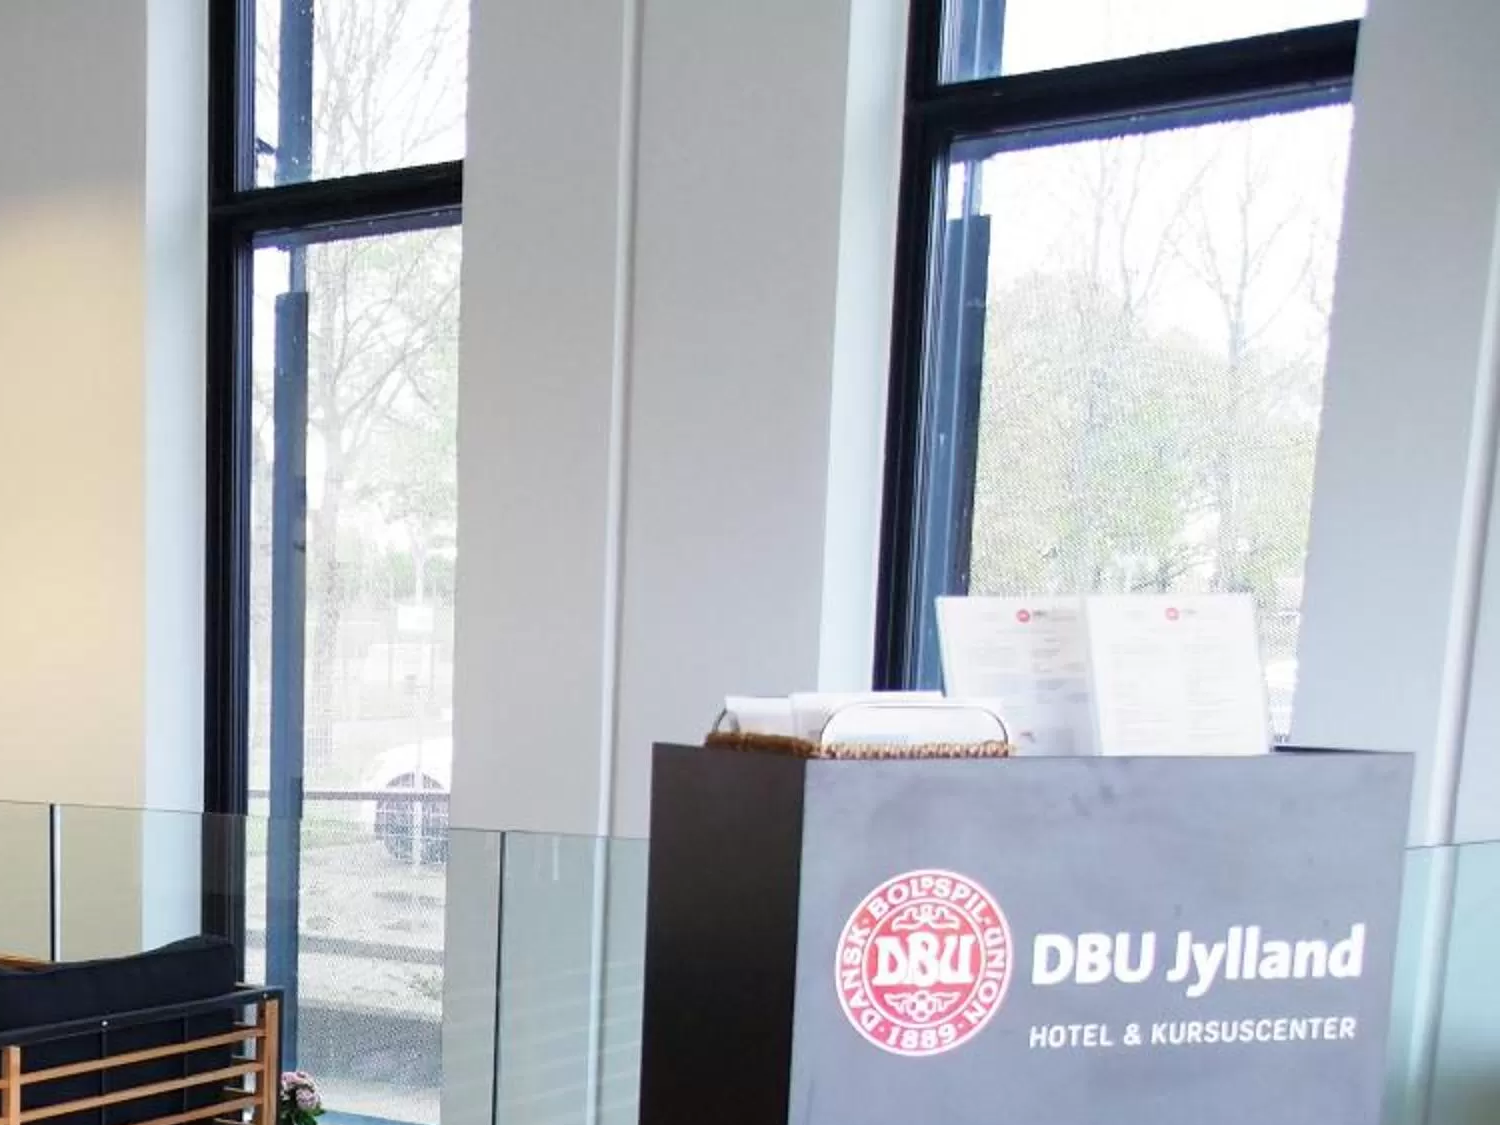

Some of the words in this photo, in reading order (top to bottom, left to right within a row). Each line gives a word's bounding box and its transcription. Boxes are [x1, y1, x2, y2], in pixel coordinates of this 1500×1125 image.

[841, 924, 882, 1032] DANSK
[871, 931, 978, 988] DBU
[963, 927, 1005, 1025] UNION
[1031, 931, 1156, 986] DBU
[1166, 923, 1366, 998] Jylland
[885, 1023, 958, 1049] 1889
[1028, 1023, 1114, 1049] HOTEL
[1123, 1023, 1142, 1046] &
[1150, 1016, 1357, 1045] KURSUSCENTER
